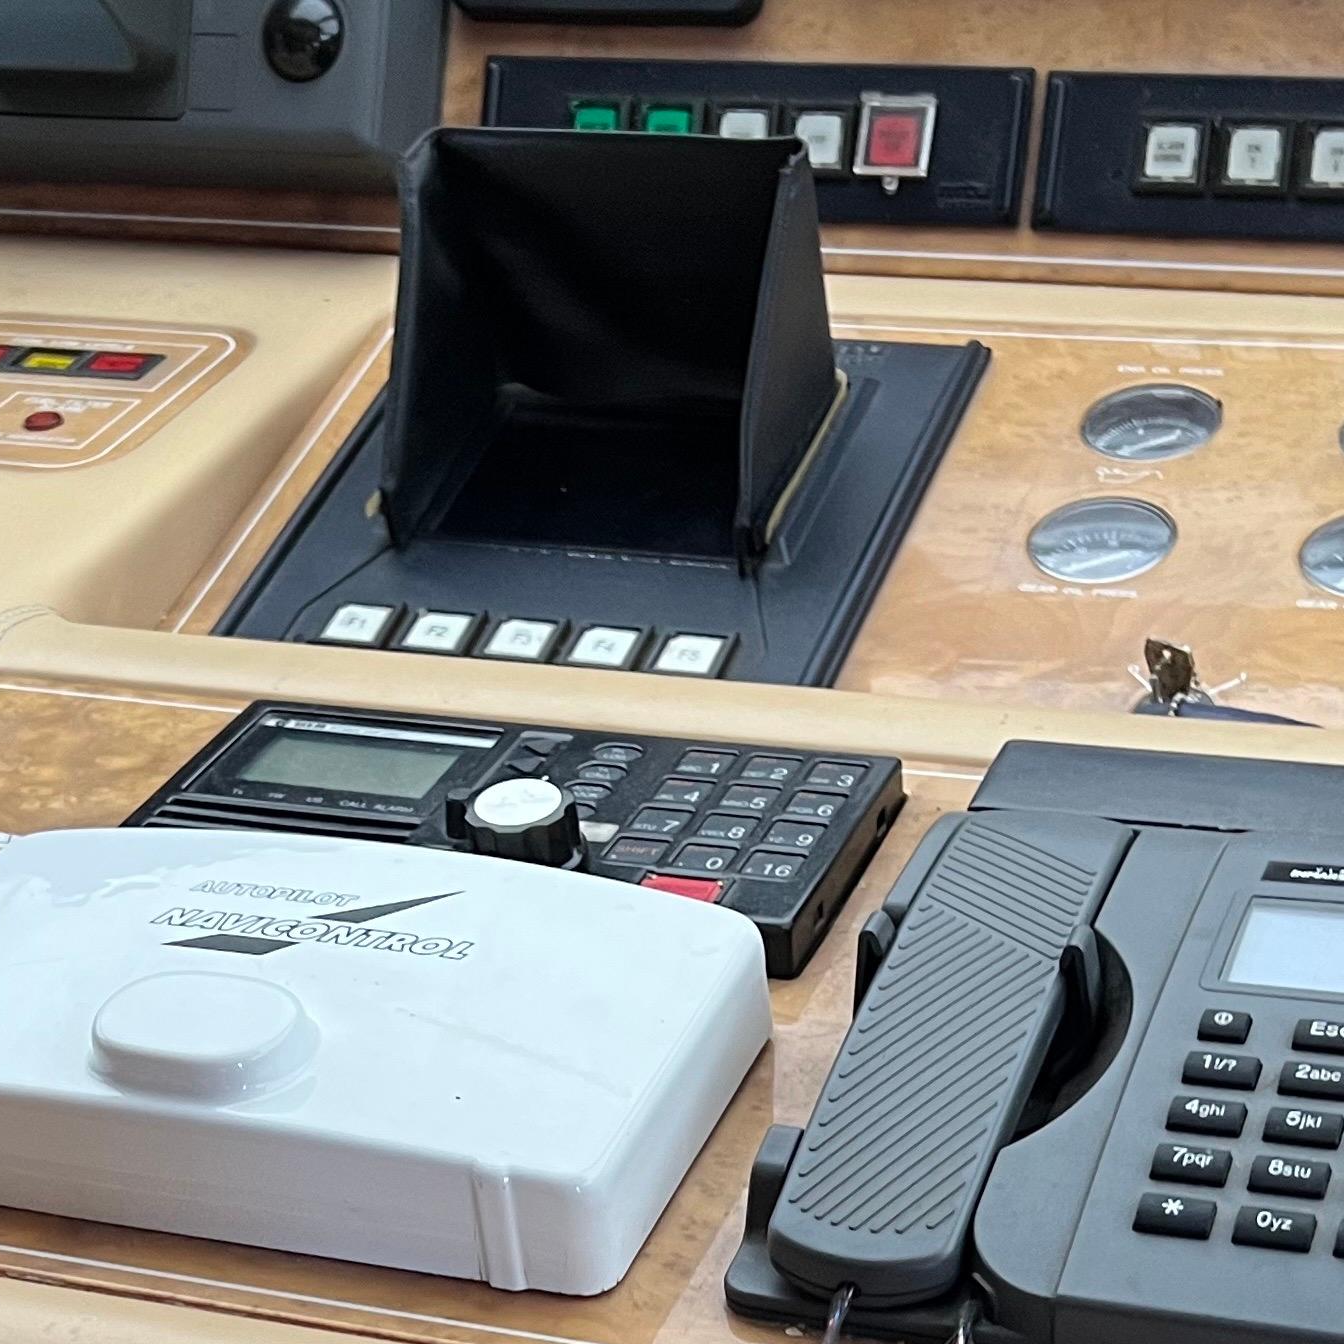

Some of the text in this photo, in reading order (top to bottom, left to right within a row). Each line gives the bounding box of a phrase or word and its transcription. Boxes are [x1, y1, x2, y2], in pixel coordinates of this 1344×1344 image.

[425, 625, 448, 639] F2
[593, 639, 614, 653] F4
[709, 763, 721, 774] 1
[770, 768, 788, 780] 2
[837, 775, 854, 788] 3
[683, 790, 700, 802] 4
[749, 797, 768, 809] 5
[817, 804, 834, 817] 6
[662, 820, 681, 832] 7
[727, 826, 746, 839] 8
[795, 834, 814, 847] 9
[705, 857, 723, 870] 0
[763, 863, 793, 877] 16
[189, 879, 360, 907] AUTOPILOT
[150, 907, 476, 961] NAVICONTROL
[1294, 1064, 1342, 1082] 2abc
[1185, 1099, 1226, 1118] 4ghi
[1285, 1110, 1322, 1130] 5jkl
[1172, 1146, 1214, 1169] 7pqr
[1268, 1159, 1312, 1179] 8stu
